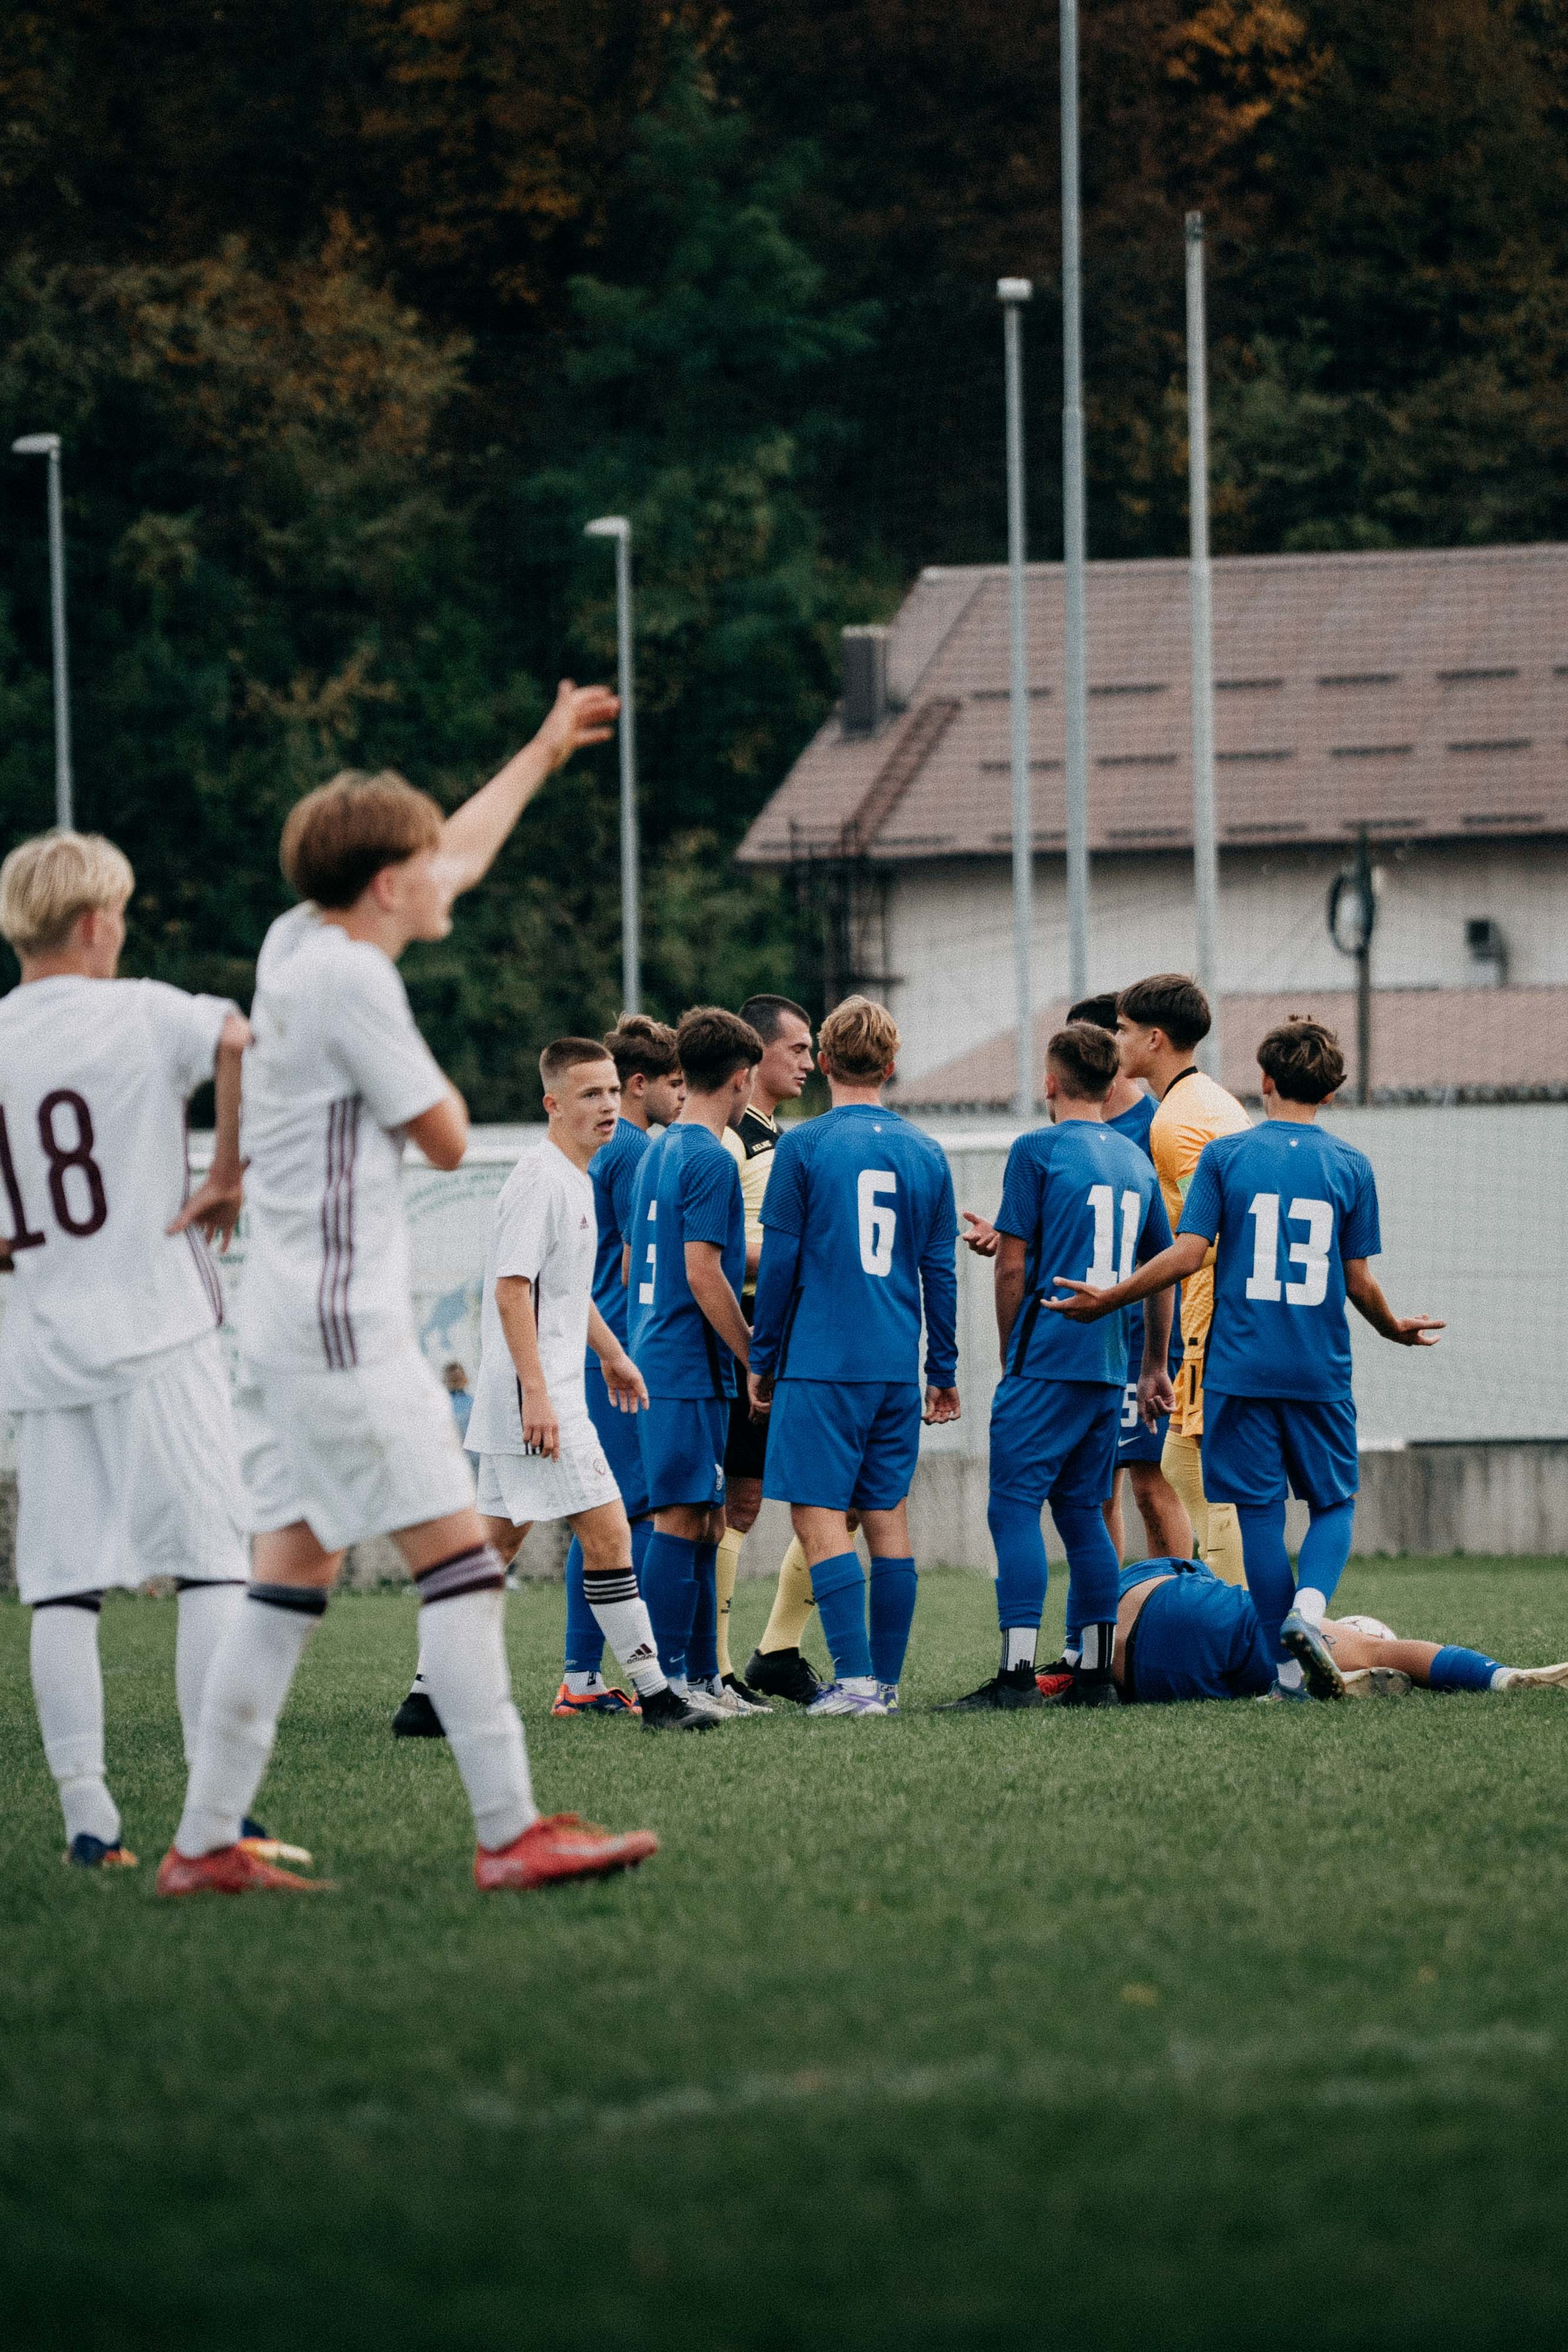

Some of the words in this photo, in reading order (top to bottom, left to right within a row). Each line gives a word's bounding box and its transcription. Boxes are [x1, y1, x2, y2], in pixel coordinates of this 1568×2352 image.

[0, 1089, 107, 1250] 18
[858, 1169, 897, 1278] 6
[1086, 1185, 1140, 1291] 11
[1246, 1193, 1334, 1306] 13
[1120, 1383, 1138, 1427] 5
